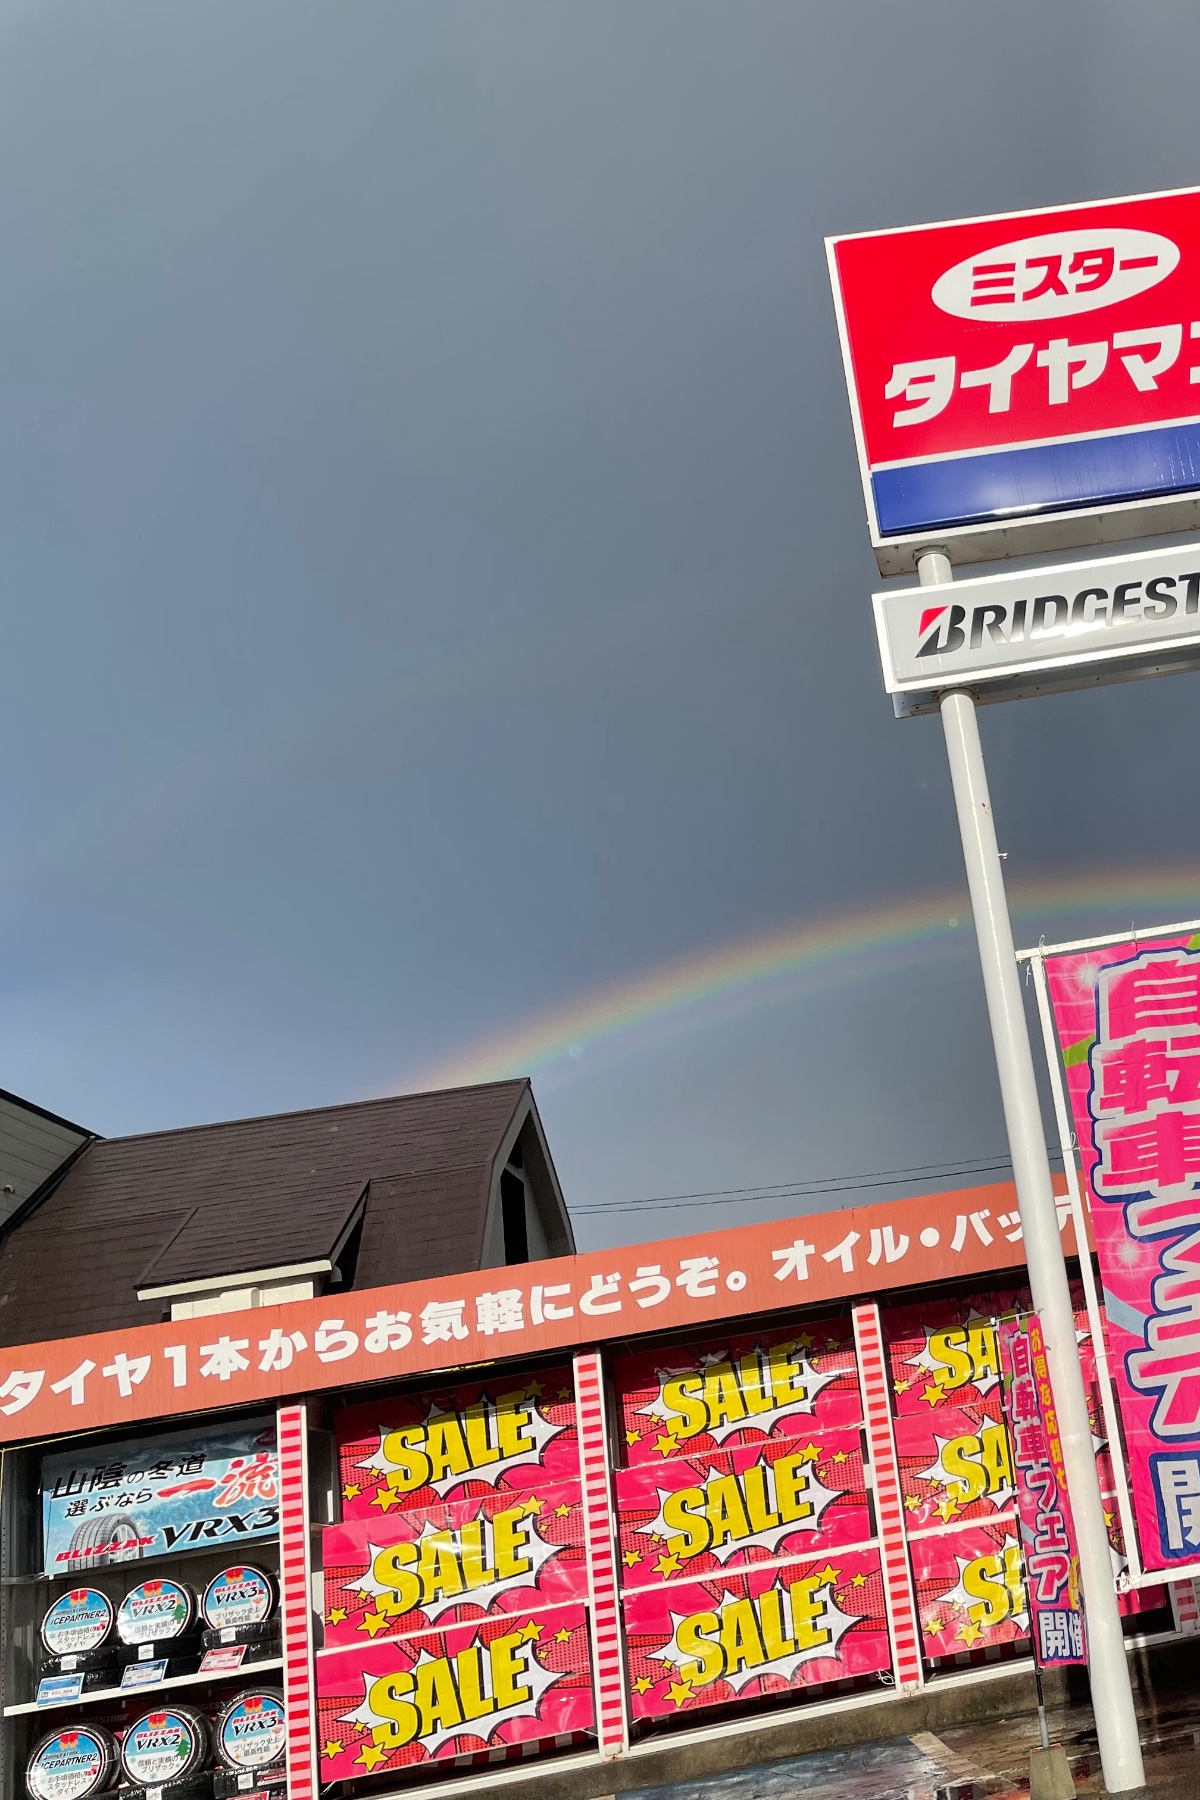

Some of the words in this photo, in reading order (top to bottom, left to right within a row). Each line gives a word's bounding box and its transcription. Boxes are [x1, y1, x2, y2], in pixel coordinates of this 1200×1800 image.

[970, 247, 1158, 307] ミスター
[661, 1342, 805, 1441] SALE
[383, 1391, 533, 1493] SALE
[51, 1454, 208, 1499] 山陰の冬道
[64, 1488, 153, 1518] 選ぶなら
[663, 1454, 813, 1559] SALE
[163, 1505, 279, 1551] VRX3
[55, 1535, 156, 1562] BLIZZAK
[374, 1507, 531, 1617] SALE
[131, 1593, 177, 1607] BLIZZAK
[214, 1580, 259, 1594] BLIZZAK
[216, 1588, 258, 1605] VRX3
[50, 1609, 107, 1626] ICEPARTNER2
[132, 1600, 176, 1618] VRX2
[676, 1575, 830, 1688] SALE
[369, 1632, 530, 1750] SALE
[233, 1711, 277, 1724] BLIZZAK
[233, 1716, 277, 1737] VRX3
[136, 1728, 181, 1739] BLIZZAK
[136, 1734, 180, 1751] VRX2
